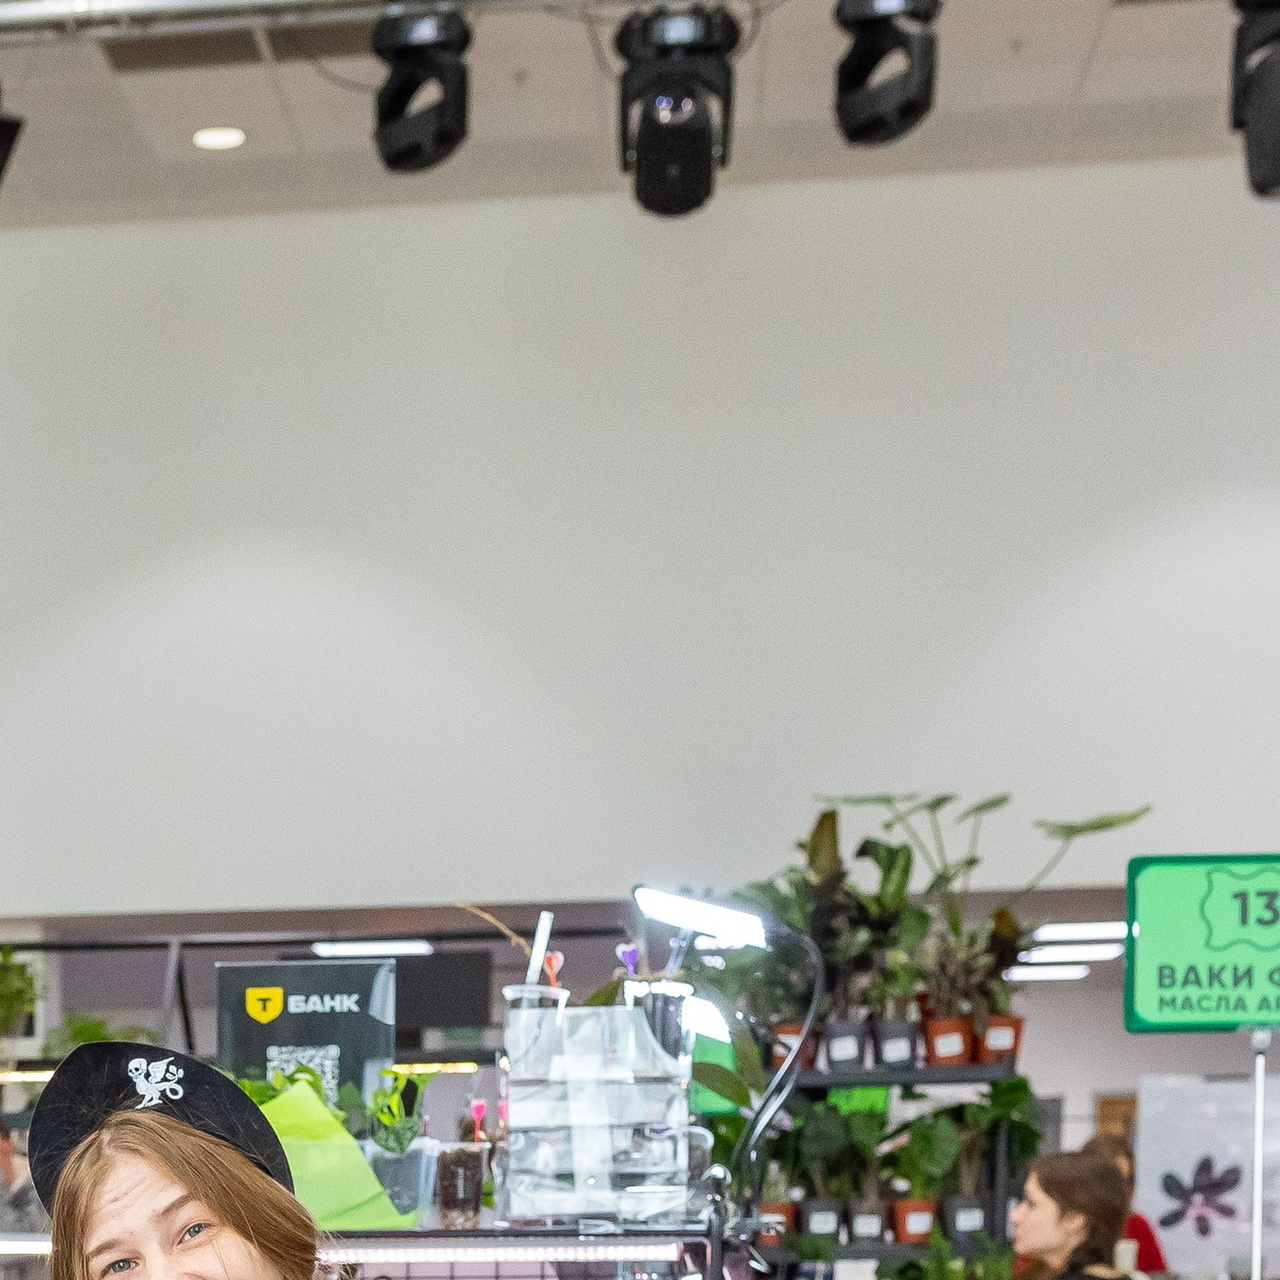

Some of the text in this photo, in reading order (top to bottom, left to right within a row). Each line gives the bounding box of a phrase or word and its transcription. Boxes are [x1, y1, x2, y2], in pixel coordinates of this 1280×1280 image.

[1157, 965, 1253, 989] ВАКИ
[287, 994, 360, 1013] БАНК
[1158, 997, 1247, 1012] МАСЛА
